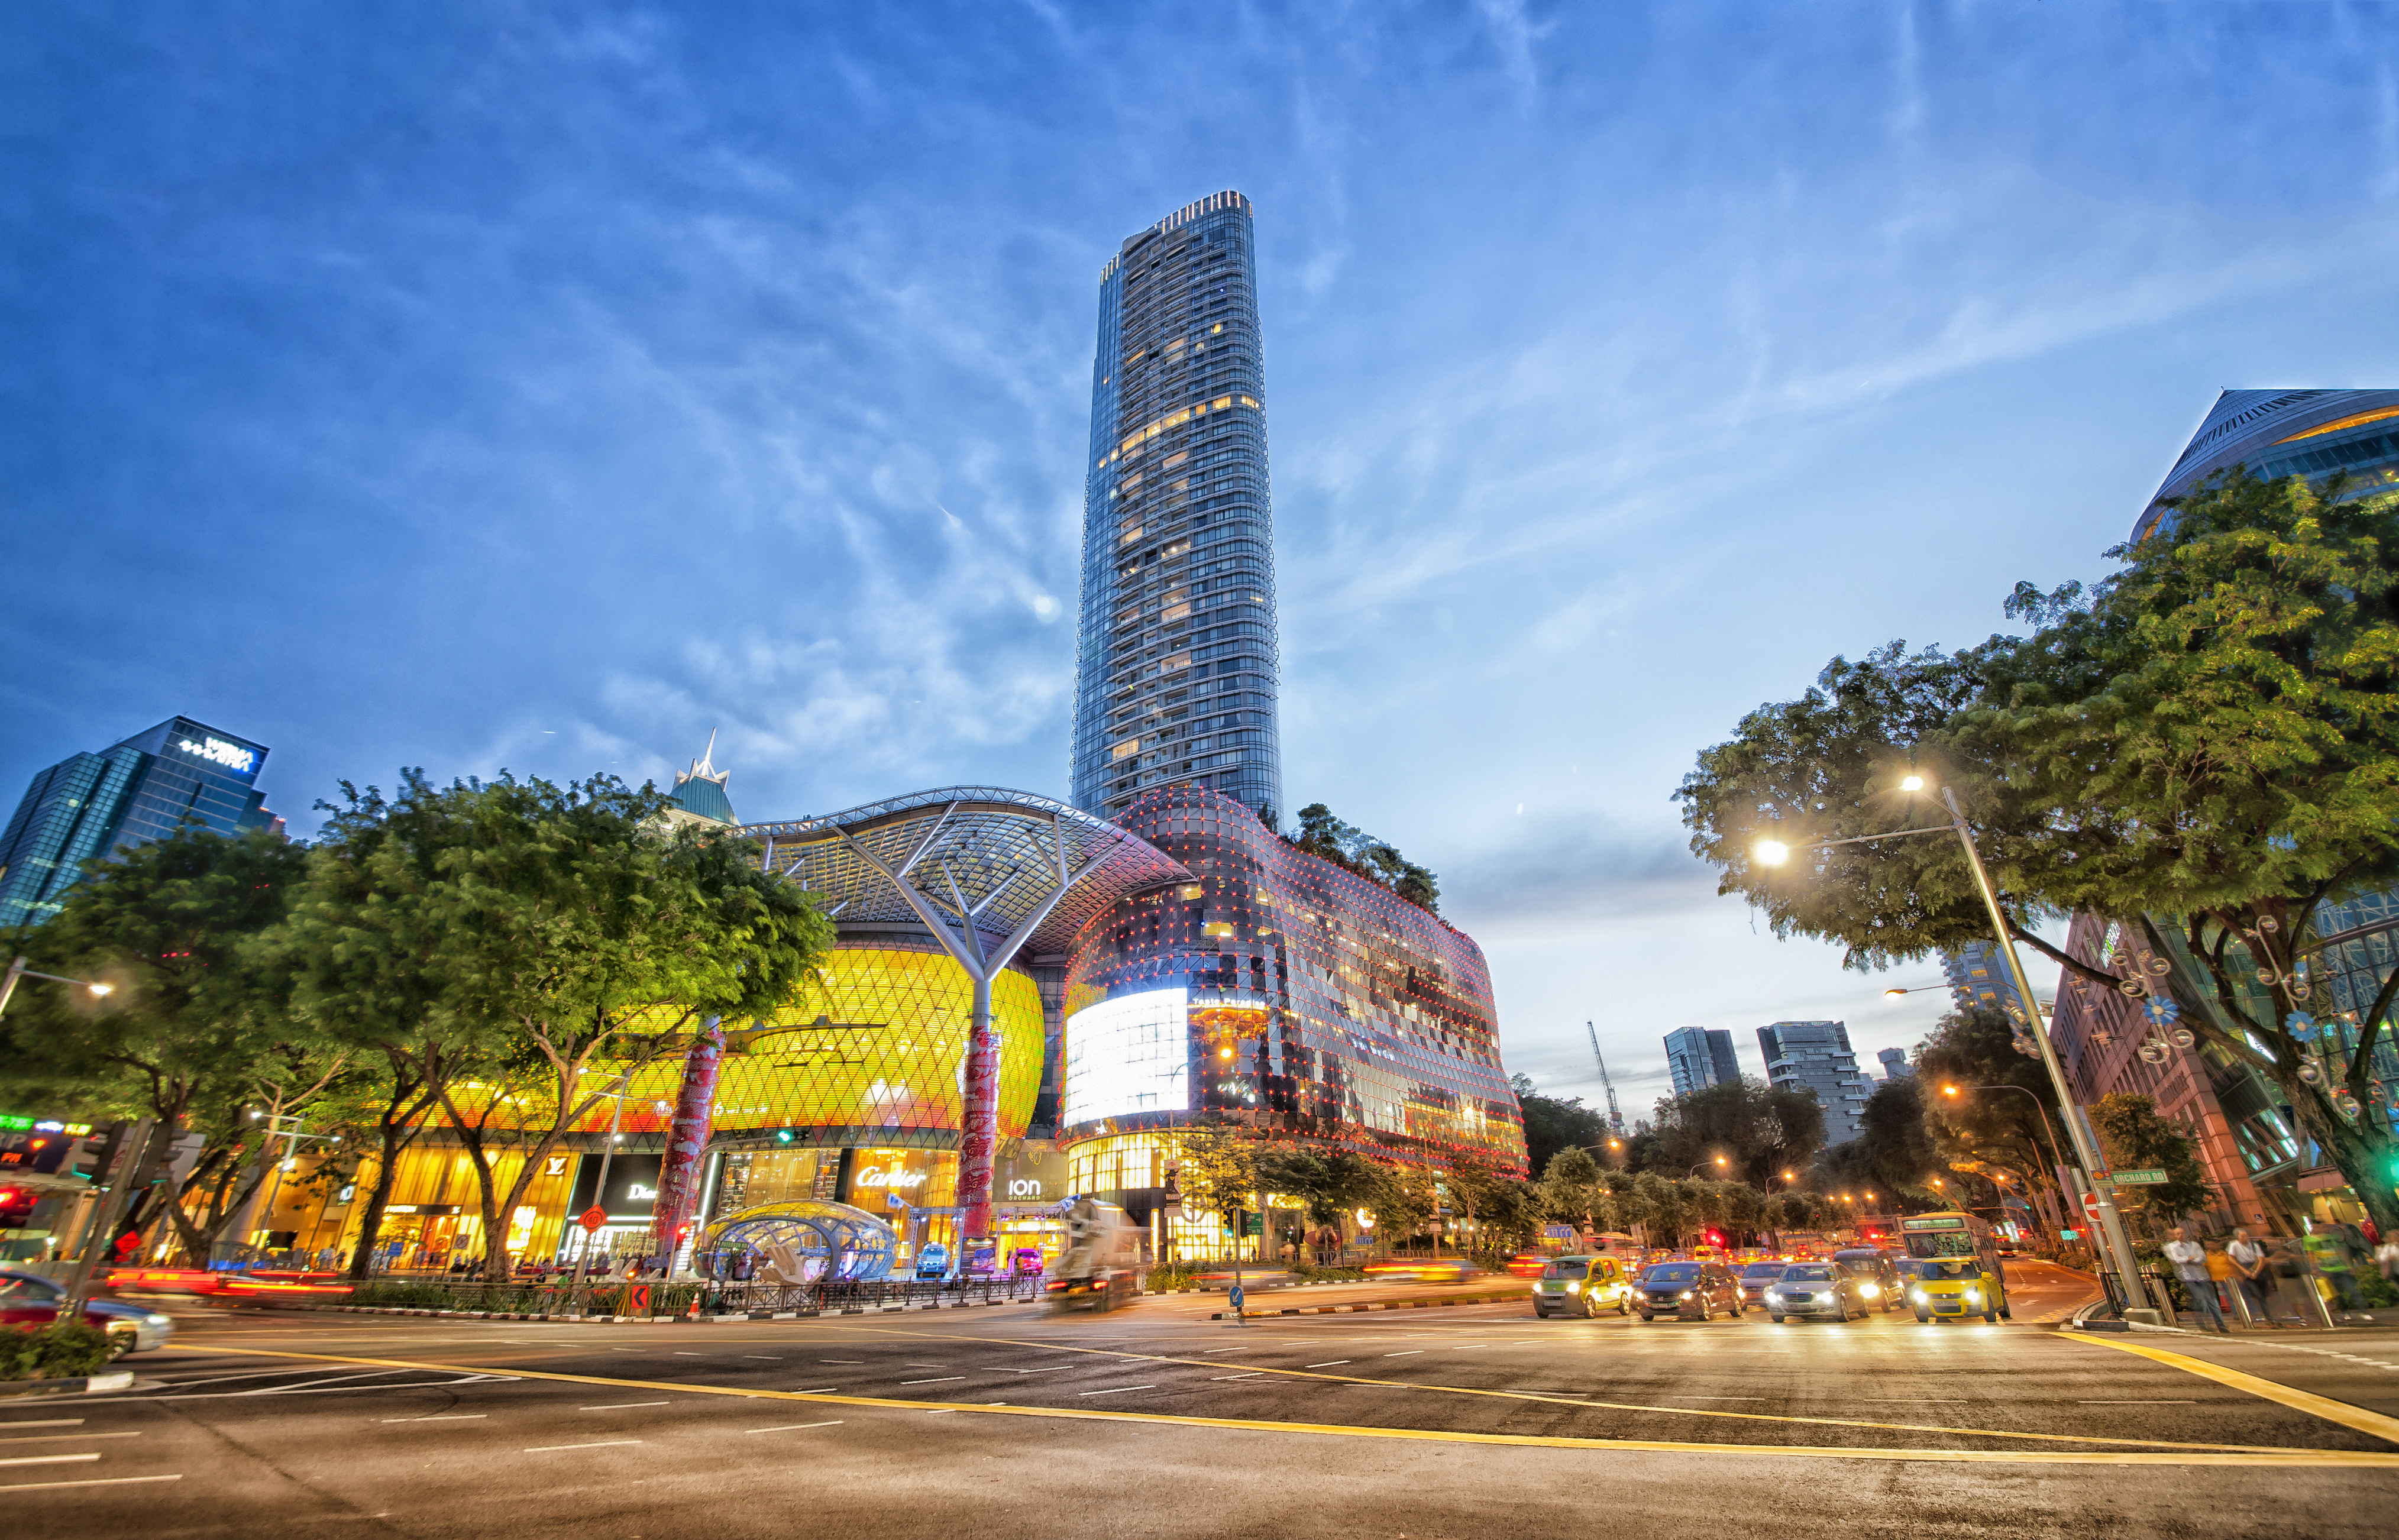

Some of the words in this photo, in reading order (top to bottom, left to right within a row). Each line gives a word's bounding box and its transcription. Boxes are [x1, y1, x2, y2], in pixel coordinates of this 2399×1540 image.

[856, 1166, 927, 1187] Cartier
[2113, 1173, 2152, 1183] ORCHARD
[2152, 1172, 2165, 1181] RD
[588, 1217, 598, 1225] 40
